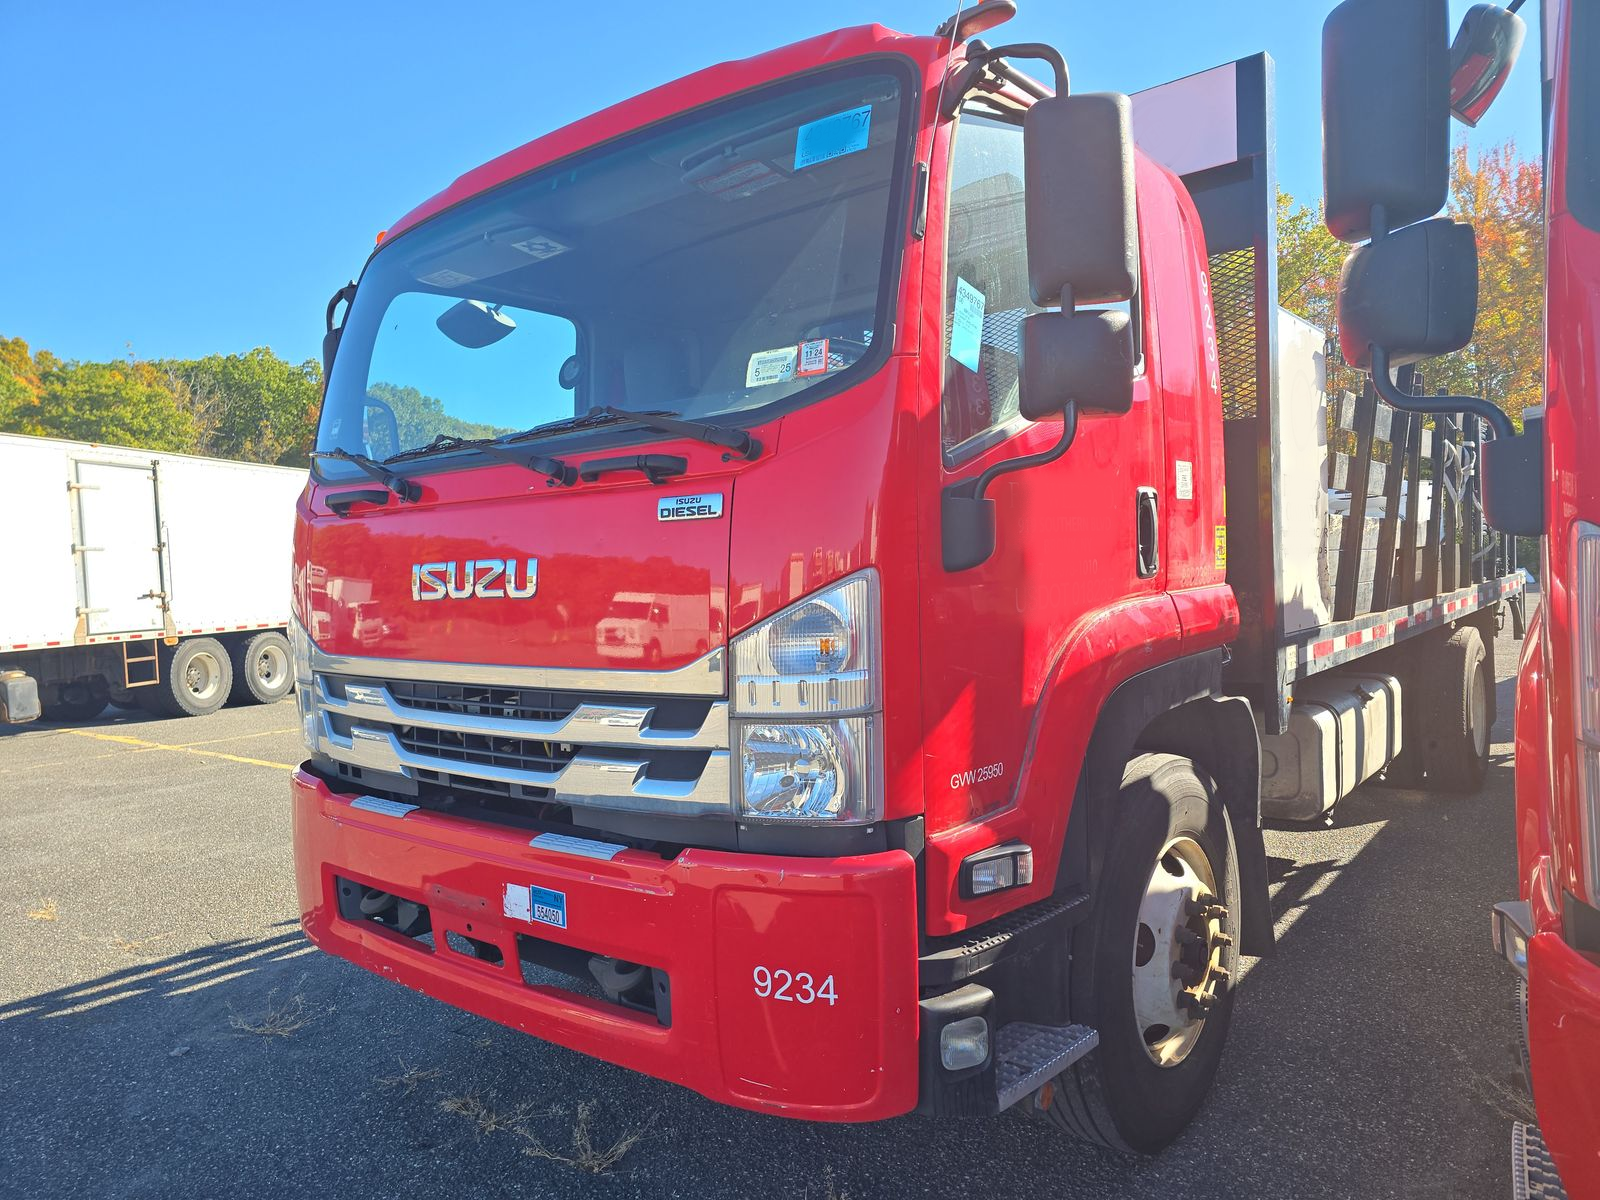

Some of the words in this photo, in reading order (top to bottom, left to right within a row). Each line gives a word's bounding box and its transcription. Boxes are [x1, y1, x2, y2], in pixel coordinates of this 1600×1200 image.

[660, 505, 717, 518] DIESEL
[676, 497, 702, 505] ISUZU
[412, 558, 537, 600] ISUZU
[950, 770, 976, 789] GVW
[977, 762, 1004, 782] 25950
[537, 905, 560, 923] 554050
[753, 965, 839, 1006] 9234
